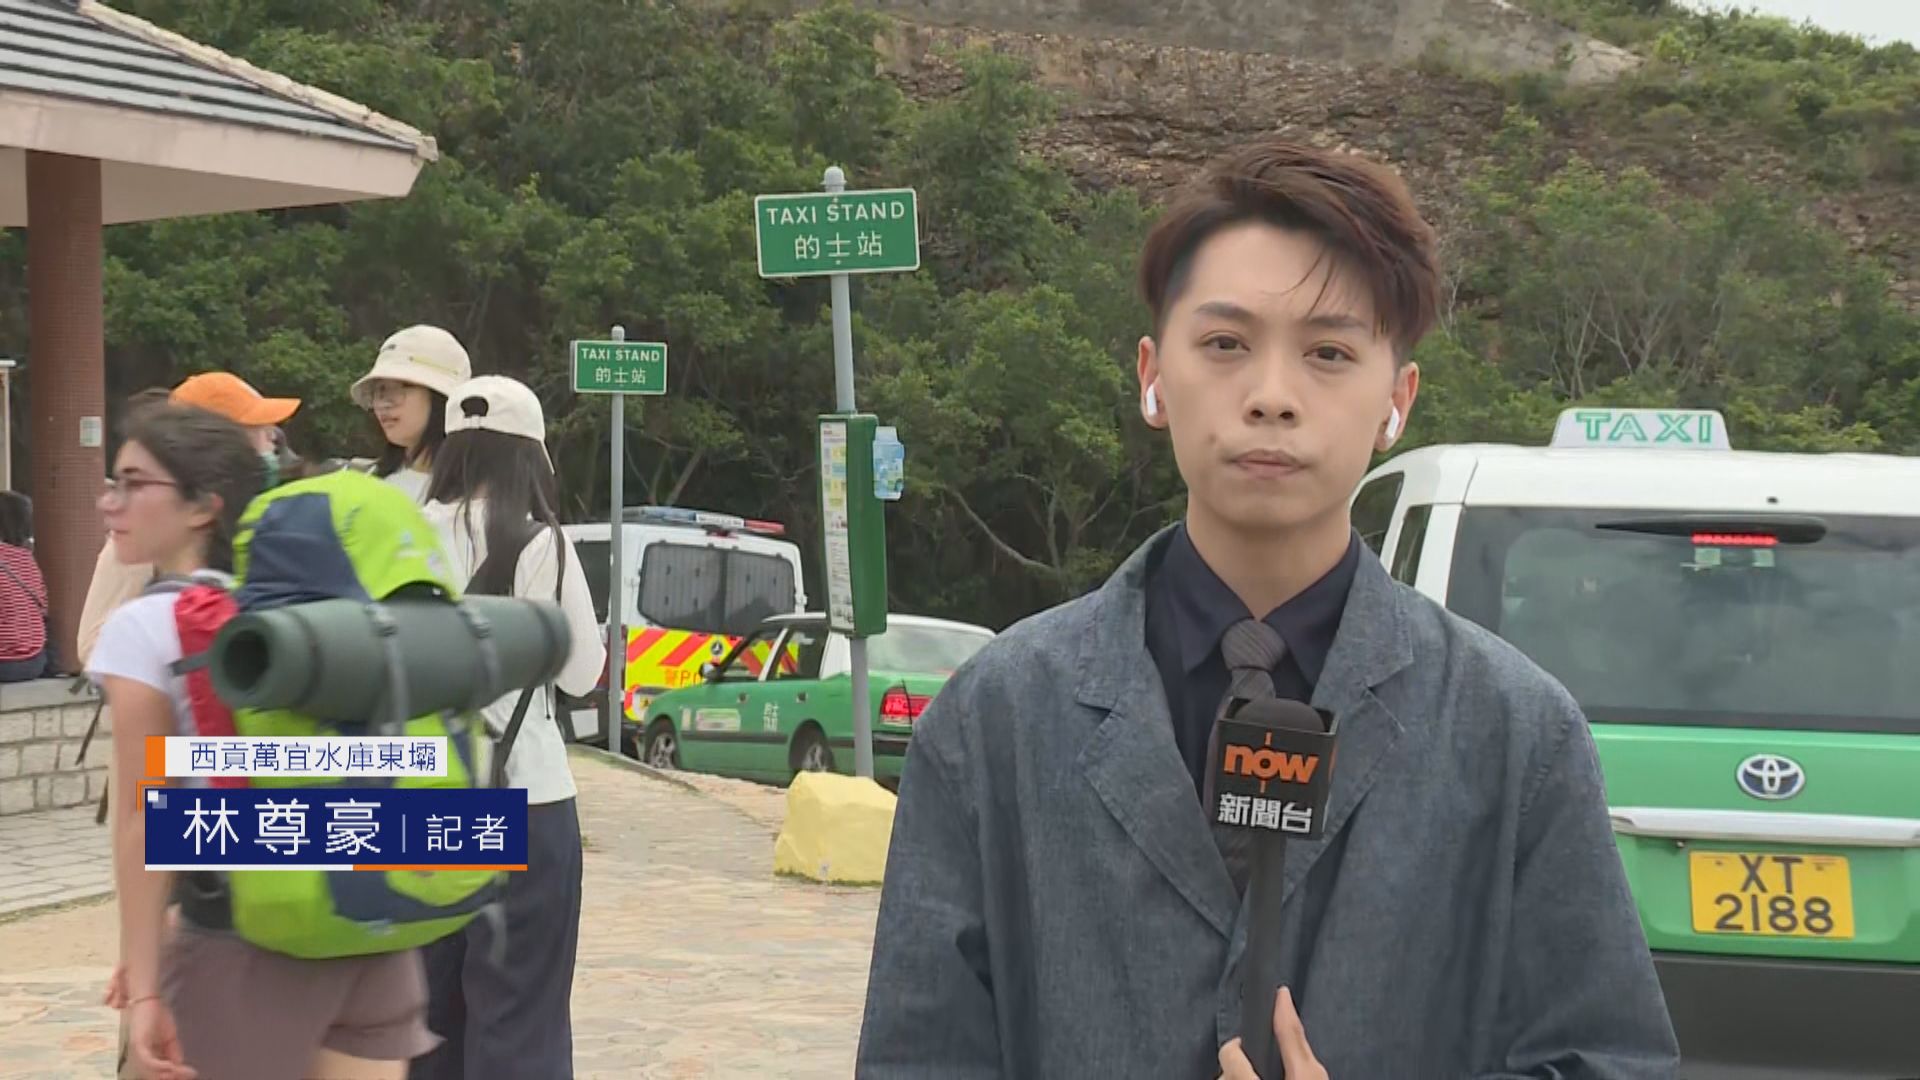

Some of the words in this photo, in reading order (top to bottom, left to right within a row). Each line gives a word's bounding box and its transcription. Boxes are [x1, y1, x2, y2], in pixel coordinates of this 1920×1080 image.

[766, 206, 817, 225] TAXI
[826, 201, 905, 222] STAND
[795, 230, 882, 260] 的士站
[581, 347, 610, 360] TAXI
[615, 349, 660, 362] STAND
[595, 366, 647, 386] 的士站
[1575, 412, 1713, 444] TAXI
[1223, 743, 1319, 784] now
[1217, 792, 1313, 833] 新聞台
[1739, 853, 1804, 894] XT
[1713, 893, 1834, 934] 2188
